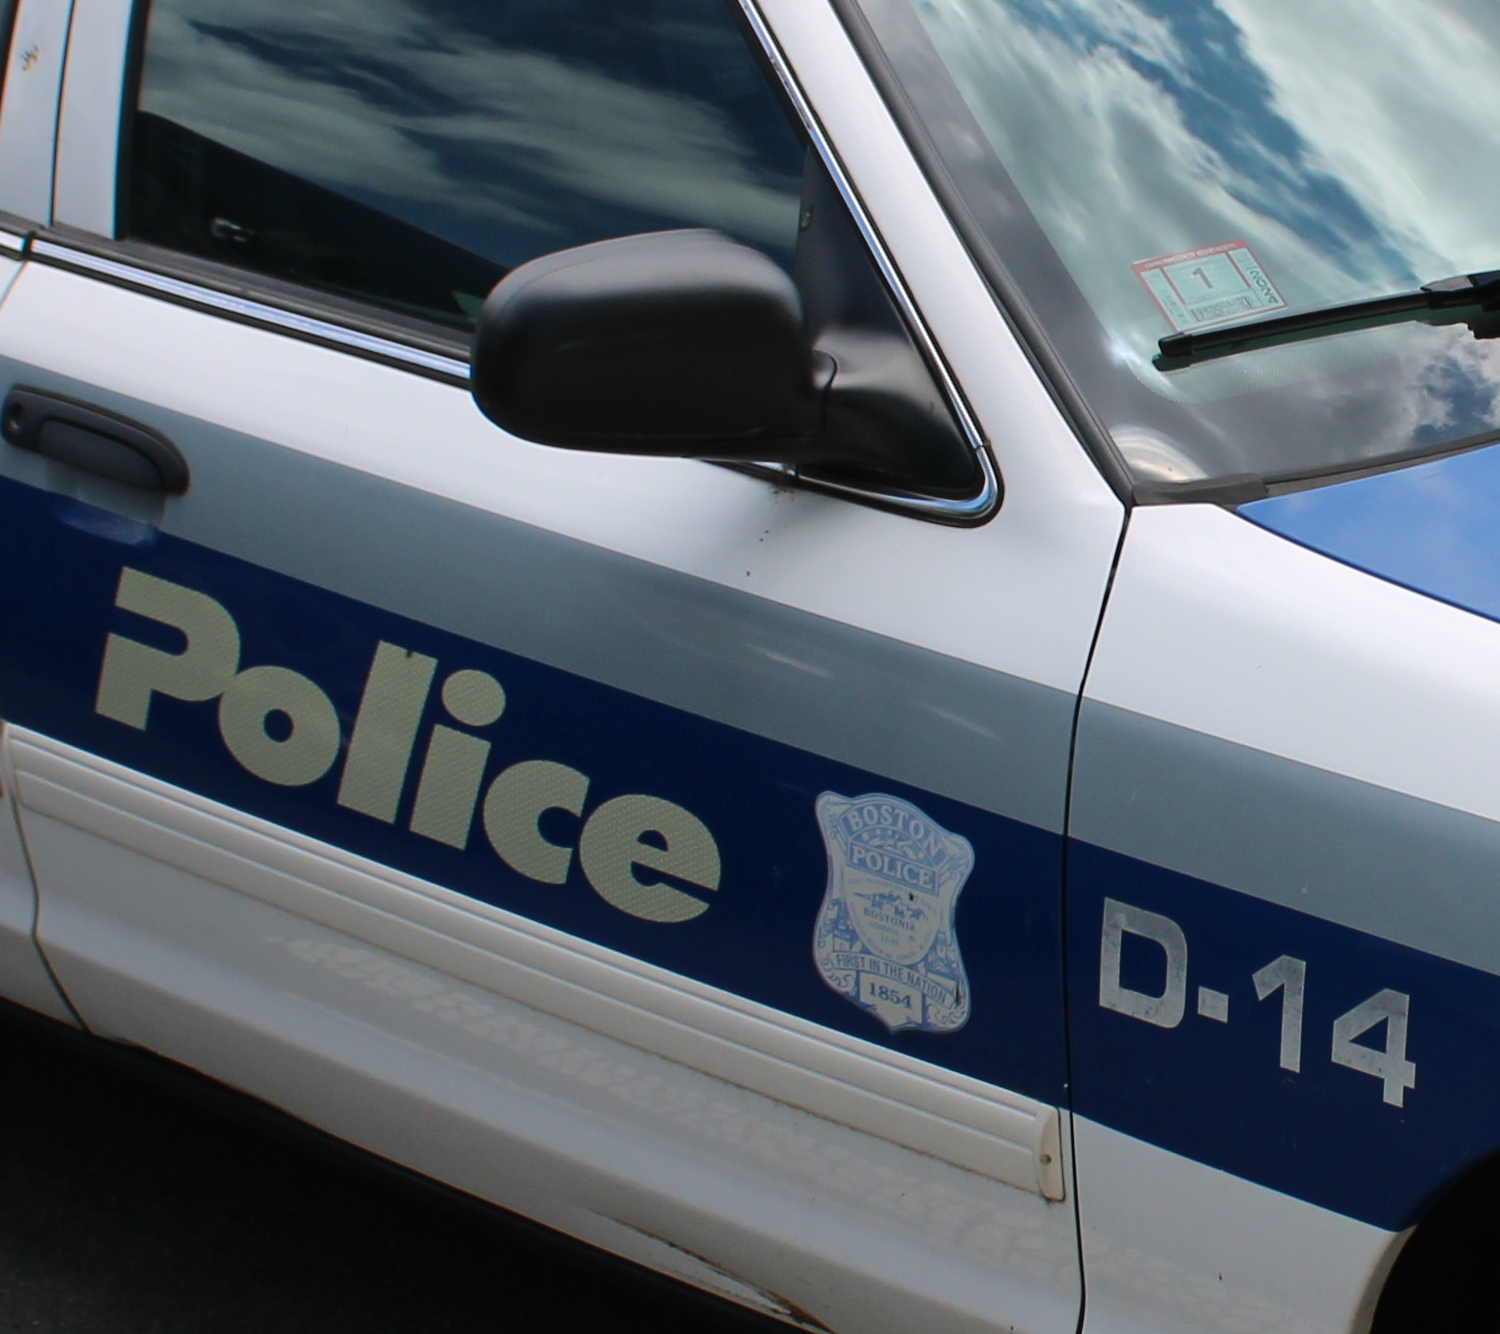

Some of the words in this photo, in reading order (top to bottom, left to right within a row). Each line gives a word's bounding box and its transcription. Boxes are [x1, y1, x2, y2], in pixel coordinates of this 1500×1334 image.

[1192, 267, 1214, 289] 1
[95, 566, 722, 924] Police
[846, 805, 941, 857] BOSTON
[851, 845, 934, 889] POLICE
[836, 953, 865, 969] FIRST
[869, 958, 880, 973] IN
[884, 962, 903, 981] THE
[906, 971, 947, 1004] NATION
[869, 982, 912, 1010] 1854
[1100, 897, 1416, 1108] D-14
